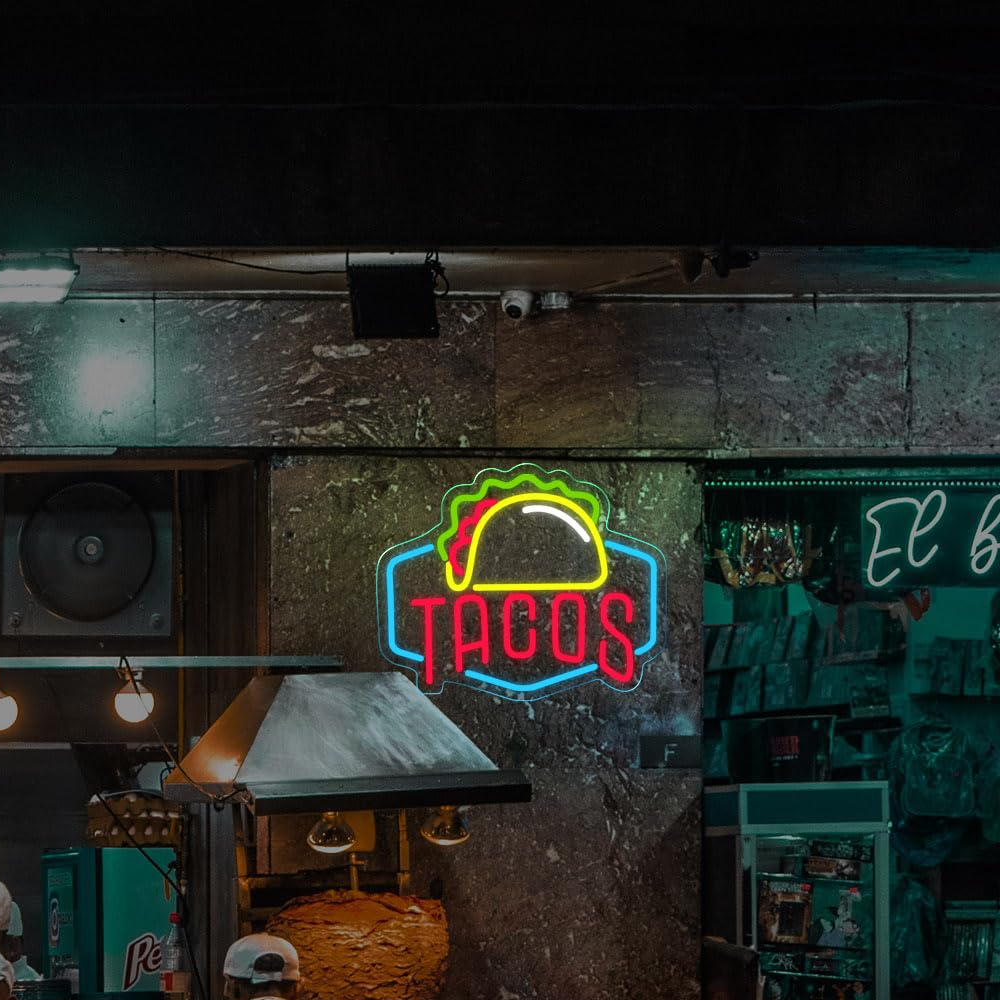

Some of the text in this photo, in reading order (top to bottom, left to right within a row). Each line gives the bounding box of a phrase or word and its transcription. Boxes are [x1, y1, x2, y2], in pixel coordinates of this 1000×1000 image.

[866, 489, 947, 587] El
[410, 592, 635, 684] TACOS
[664, 743, 679, 762] F
